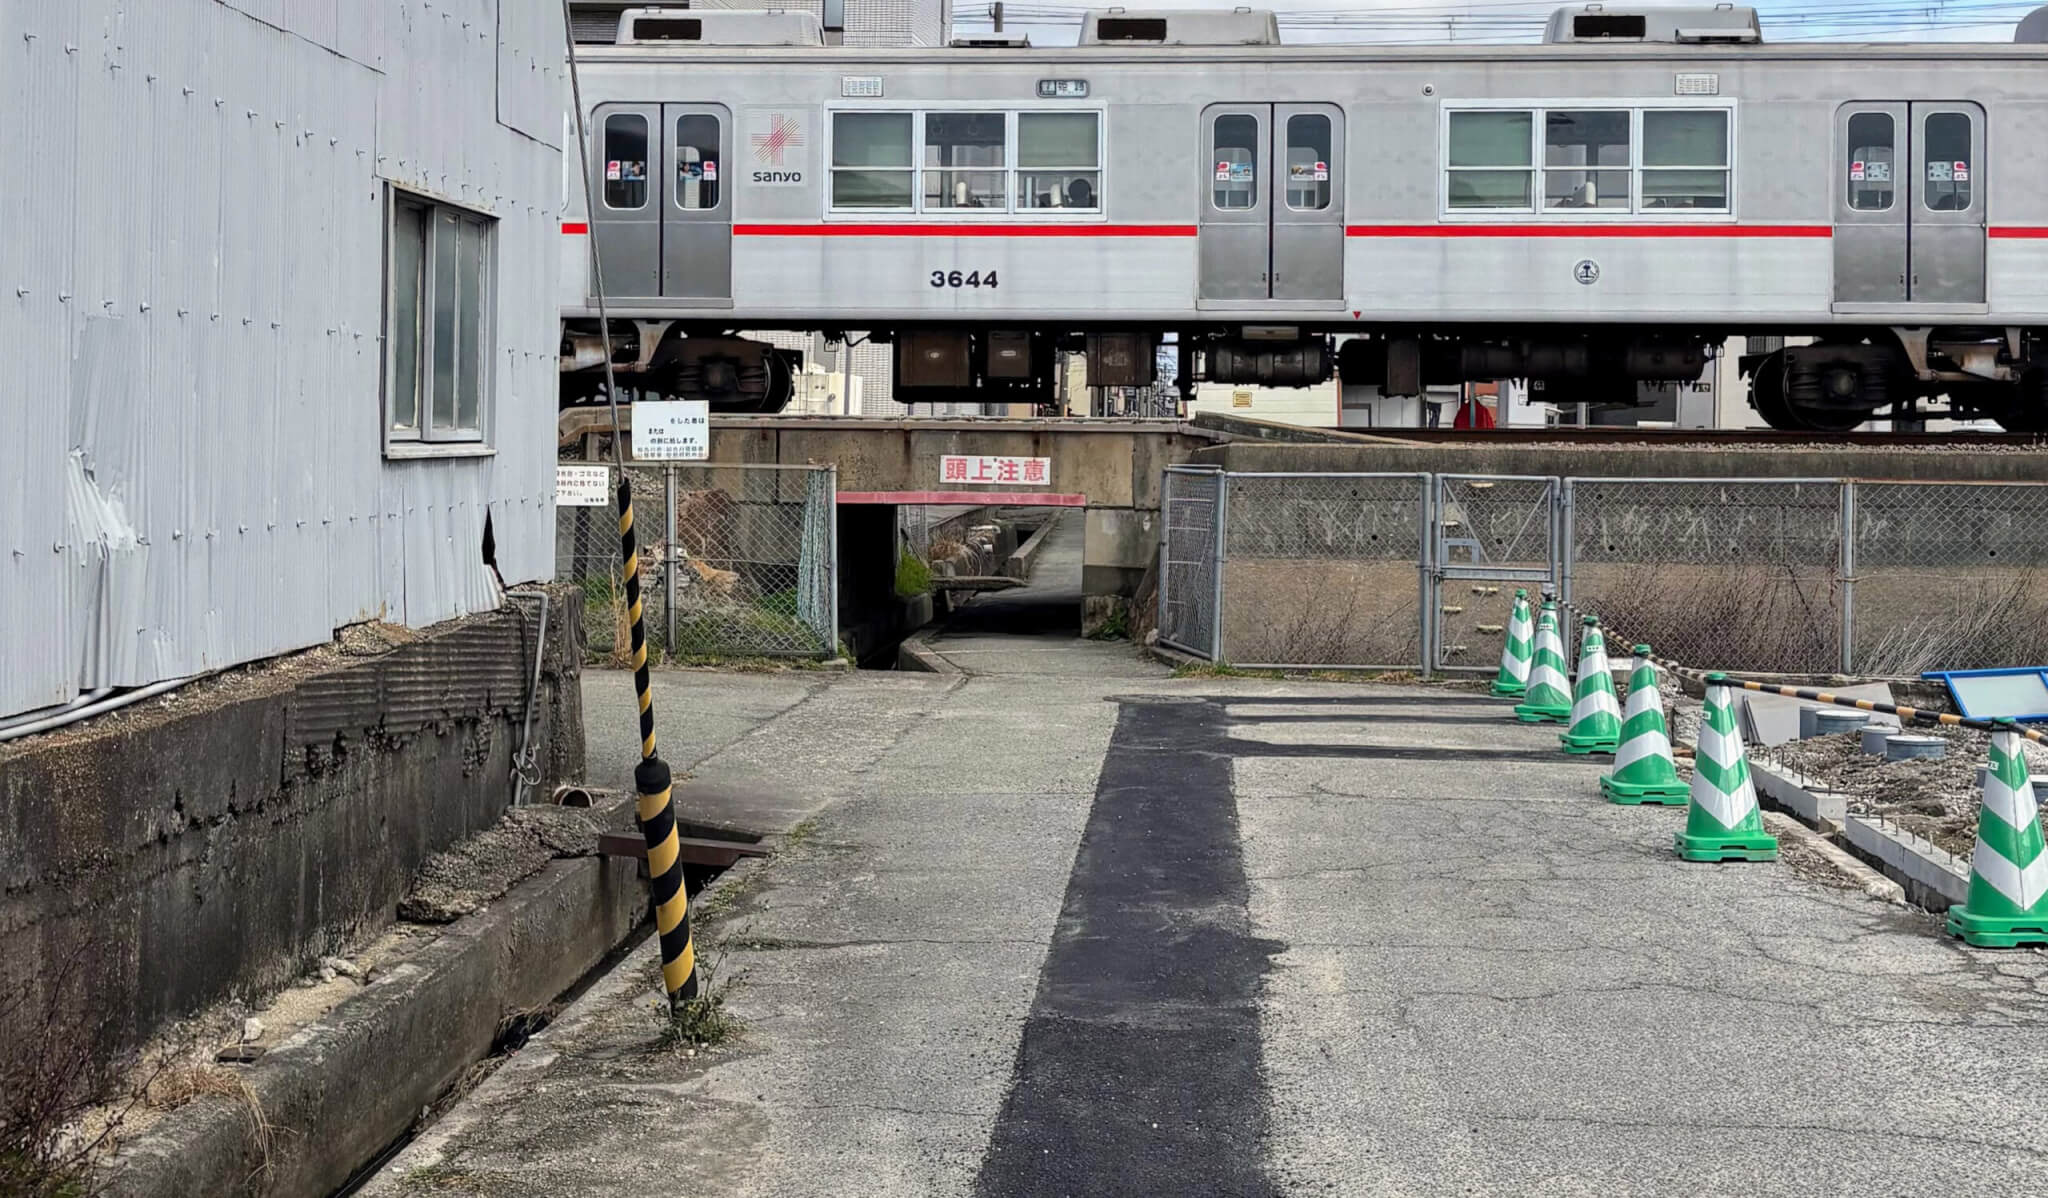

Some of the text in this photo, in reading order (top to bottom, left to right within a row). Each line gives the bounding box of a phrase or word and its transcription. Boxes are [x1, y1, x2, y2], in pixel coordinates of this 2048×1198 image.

[752, 170, 801, 183] sanyo
[931, 270, 998, 288] 3644
[945, 458, 1045, 481] 頭上注意
